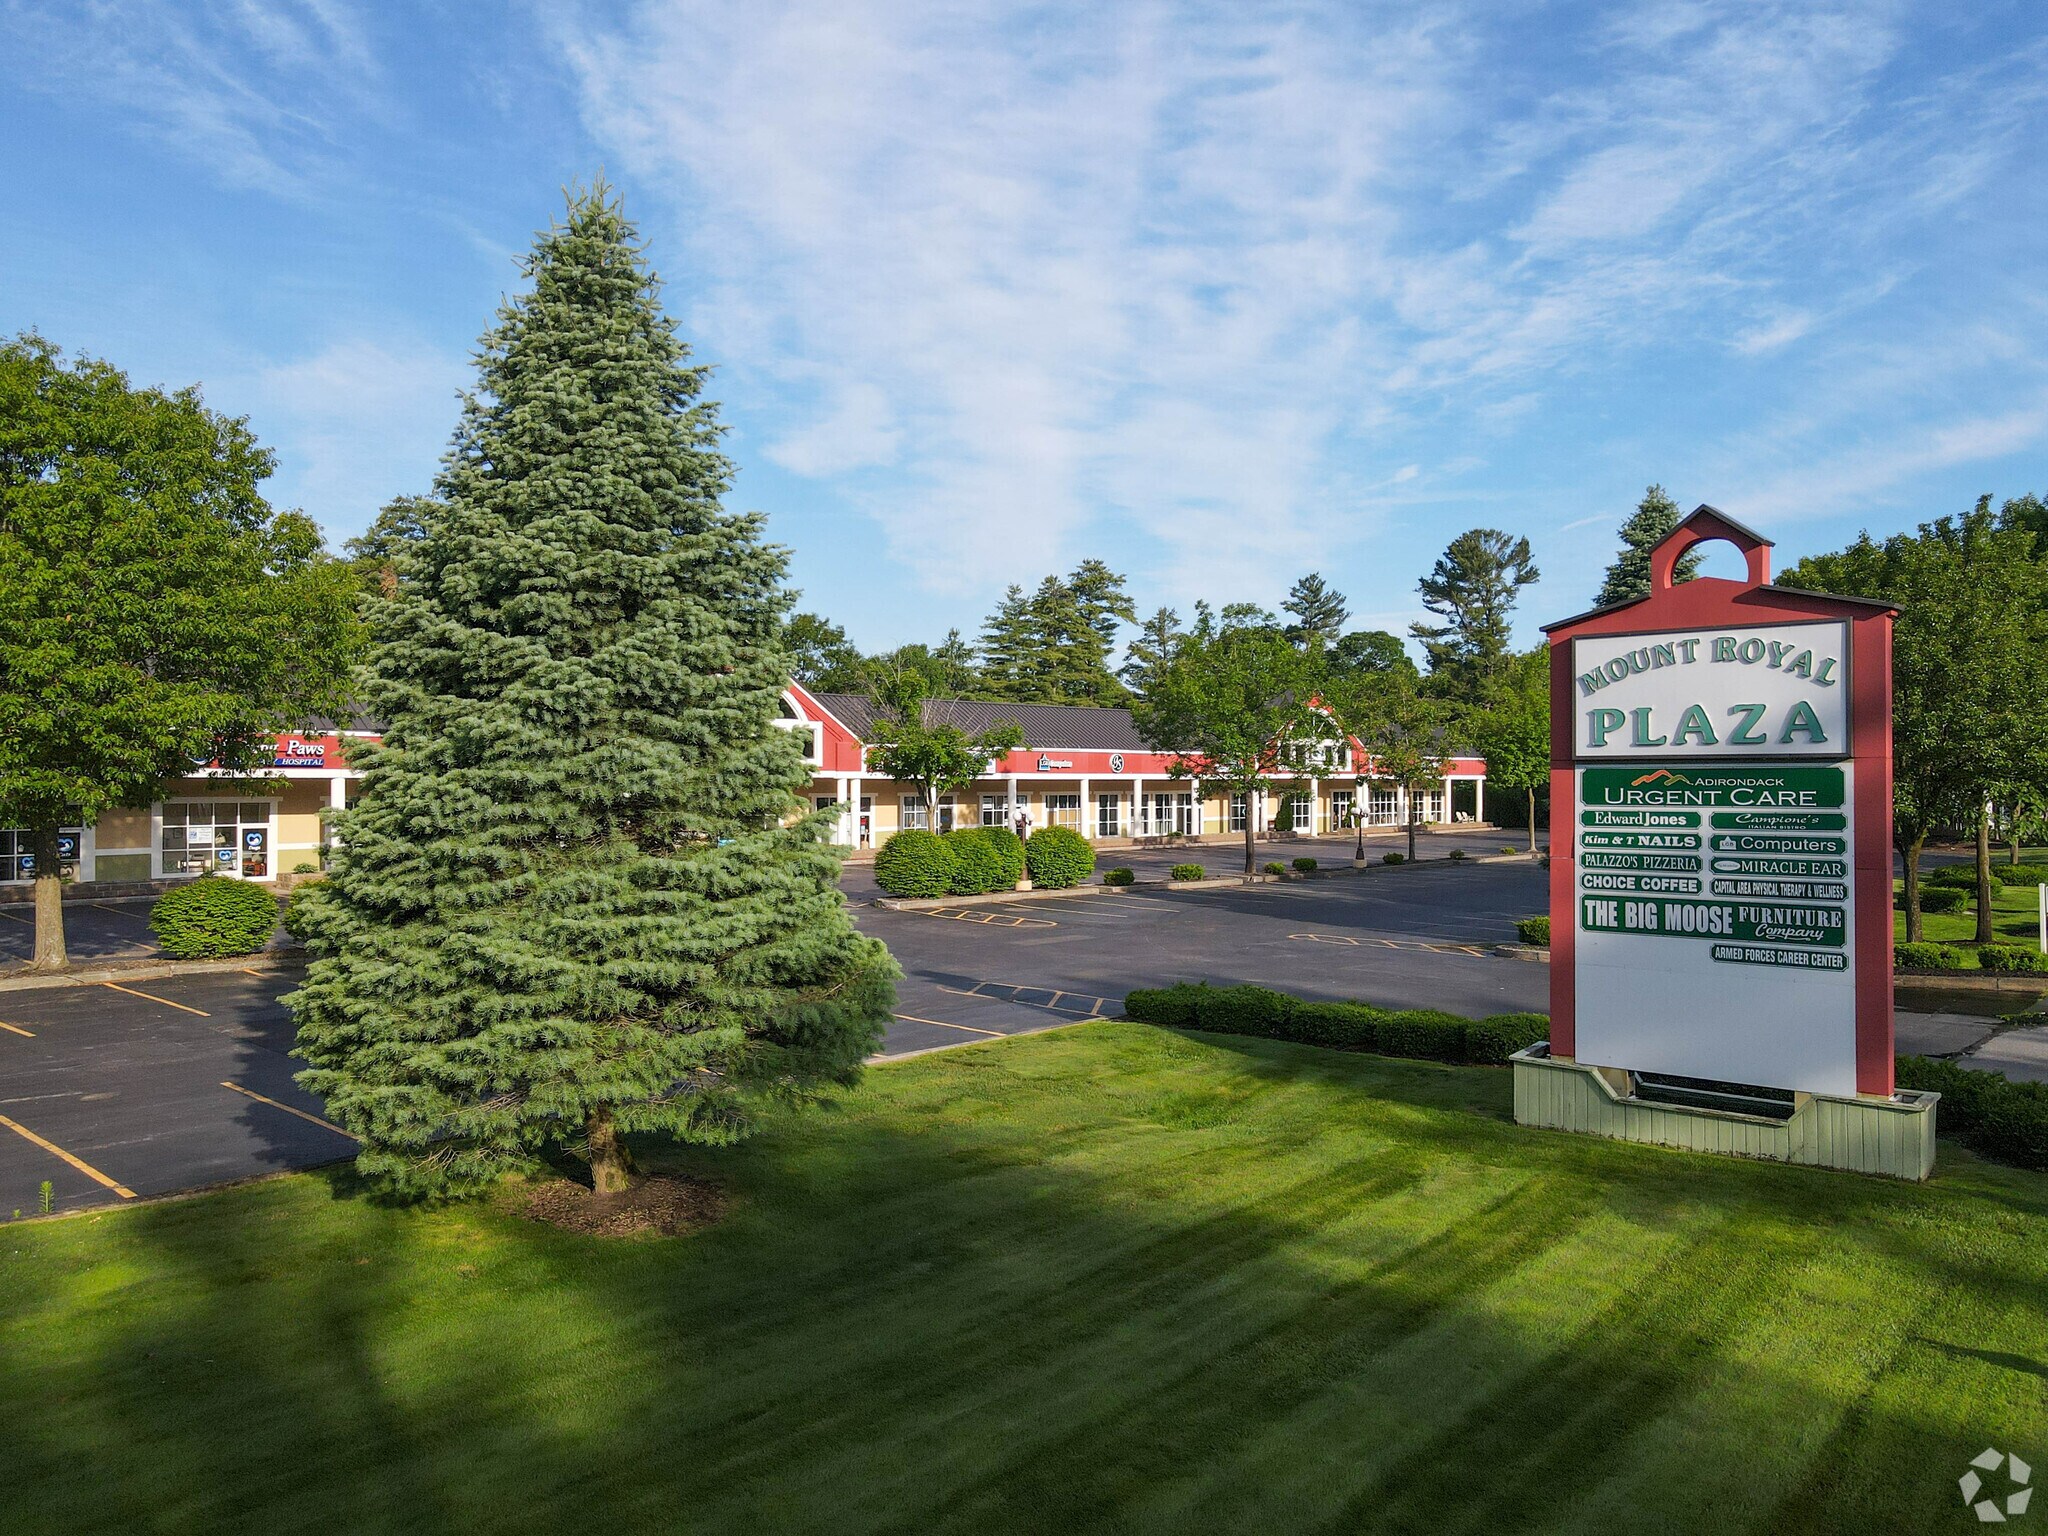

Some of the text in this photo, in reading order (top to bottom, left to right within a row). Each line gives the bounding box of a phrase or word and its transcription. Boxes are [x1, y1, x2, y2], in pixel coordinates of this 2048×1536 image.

[1580, 636, 1837, 695] MOUNT ROYAL
[1590, 701, 1828, 747] PLAZA
[286, 740, 325, 755] Paws
[1694, 777, 1784, 787] ADIRONDACK
[1604, 787, 1817, 807] URGENT CARE
[1594, 811, 1687, 826] Edward Jones
[1735, 813, 1819, 827] Campione's
[1584, 835, 1696, 847] Kim & T NAILS
[1740, 837, 1837, 852] Computers
[1585, 854, 1697, 870] PALAZZO'S PIZZERIA
[1741, 860, 1842, 876] MIRACLE EAR
[1583, 874, 1698, 892] CHOICE COFFEE
[1714, 881, 1844, 899] CAPITAL AREA PHYSICAL THERAPY & WELLNESS
[1584, 899, 1842, 934] THE BIG MOOSE FURNITURE
[1755, 923, 1824, 941] Company
[1715, 946, 1843, 967] ARMED FORCES CAREER CENTER
